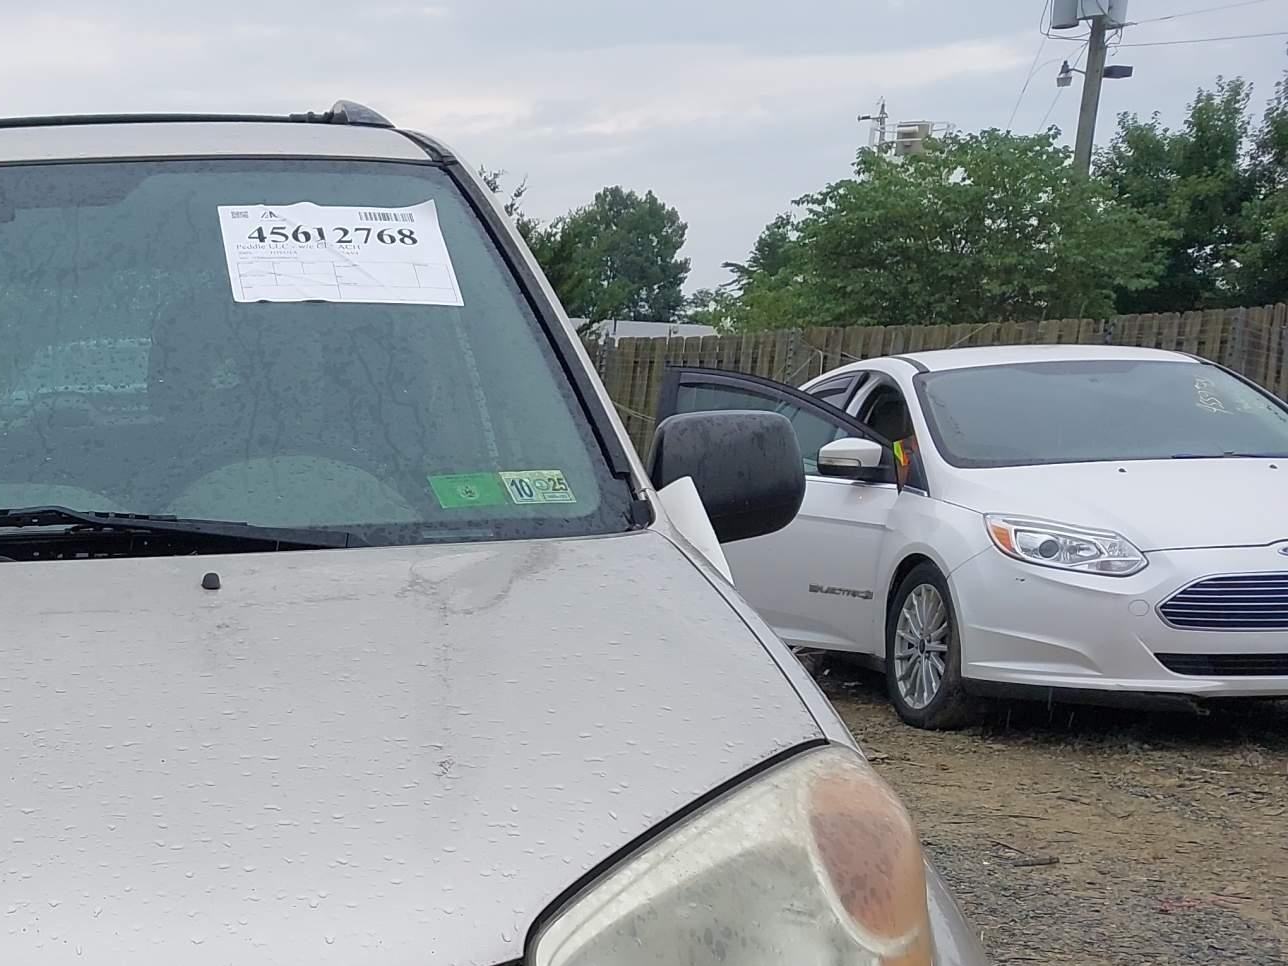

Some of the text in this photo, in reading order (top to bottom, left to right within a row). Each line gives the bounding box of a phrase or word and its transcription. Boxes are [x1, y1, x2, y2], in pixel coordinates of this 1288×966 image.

[247, 225, 418, 246] 45612768
[510, 478, 534, 499] 10
[547, 477, 569, 492] 25
